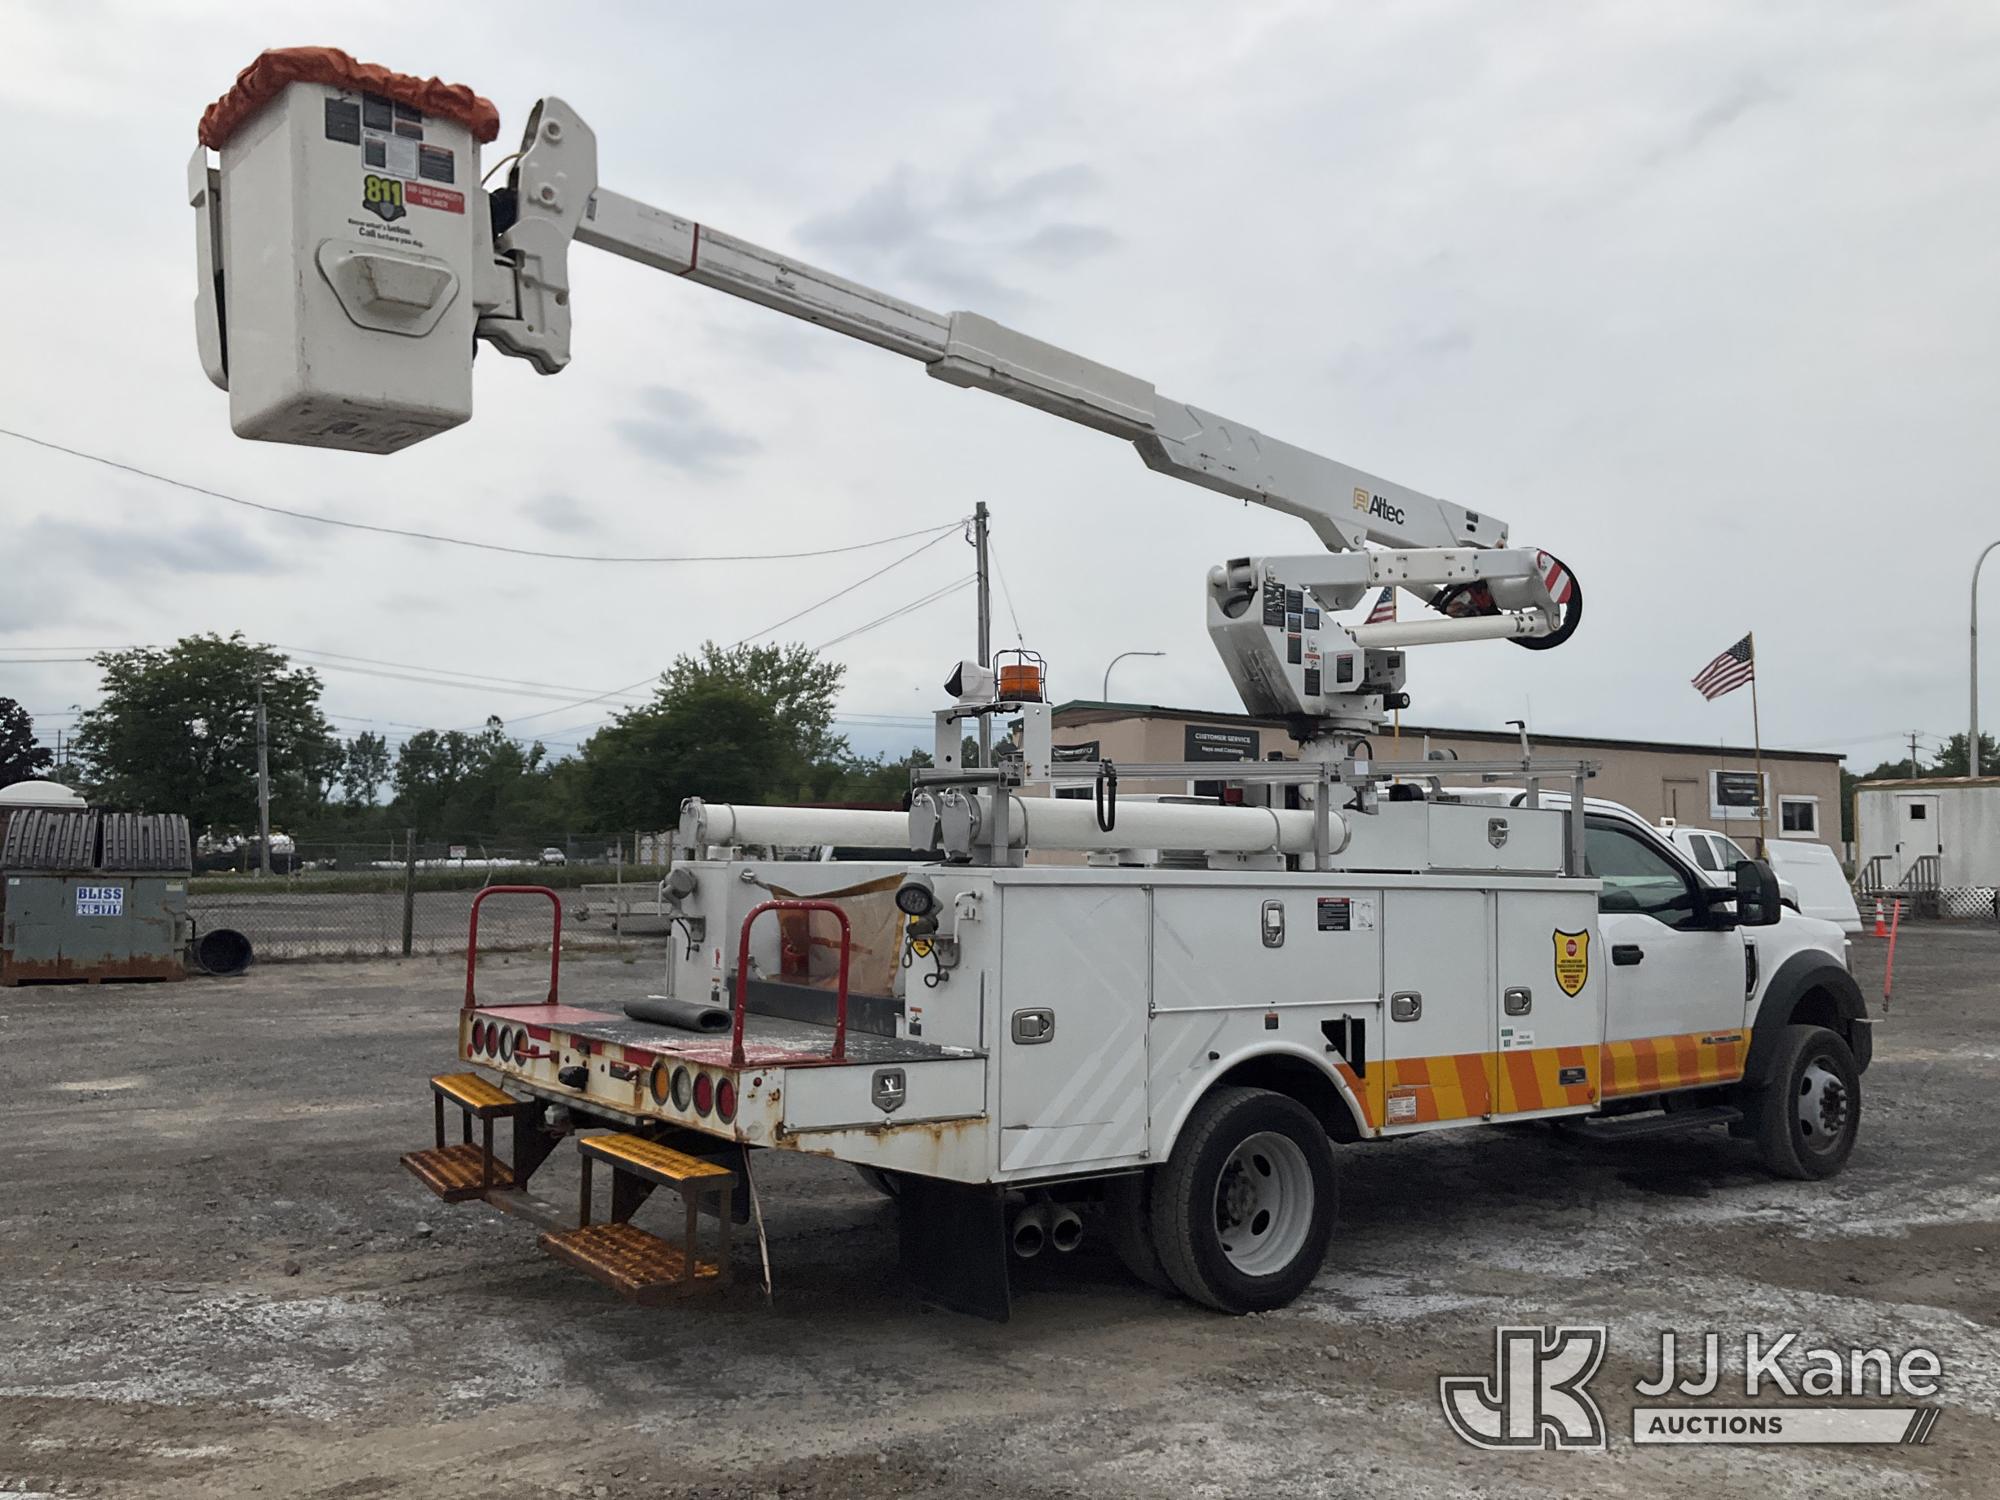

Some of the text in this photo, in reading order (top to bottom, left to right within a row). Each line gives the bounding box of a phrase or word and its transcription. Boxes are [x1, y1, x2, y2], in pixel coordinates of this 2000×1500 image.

[365, 175, 402, 206] 811
[359, 227, 376, 238] Call
[1369, 495, 1405, 525] Altec
[1195, 732, 1251, 744] CUSTOMER SERVICE
[78, 888, 122, 900] BLISS
